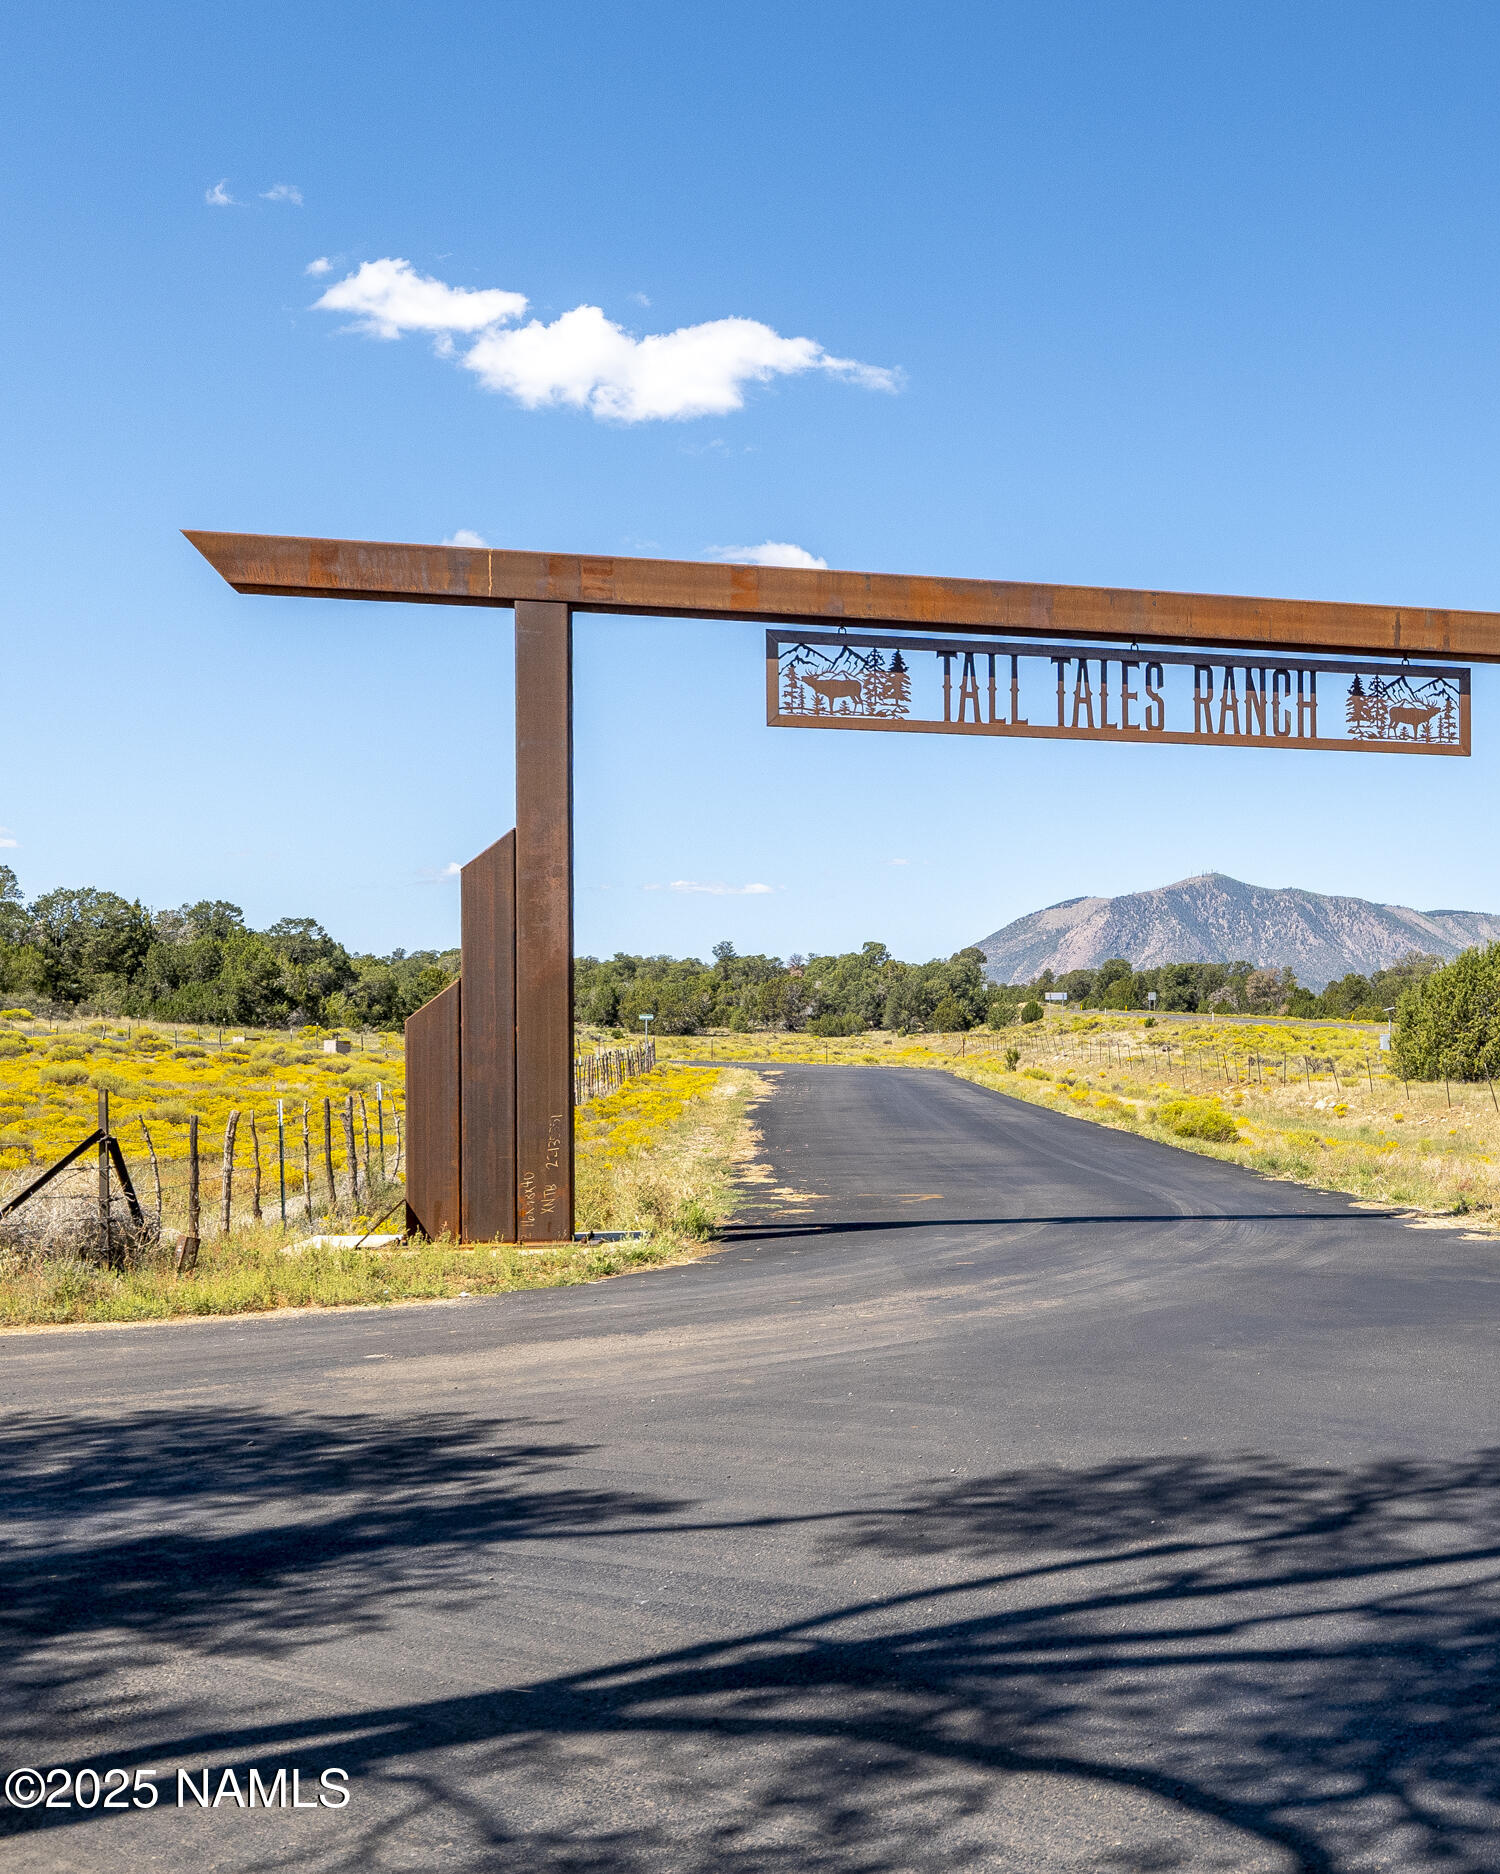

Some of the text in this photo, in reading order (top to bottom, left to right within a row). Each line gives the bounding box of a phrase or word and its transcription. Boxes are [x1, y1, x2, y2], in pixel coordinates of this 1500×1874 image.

[936, 651, 1318, 739] TALL TALES RANCH
